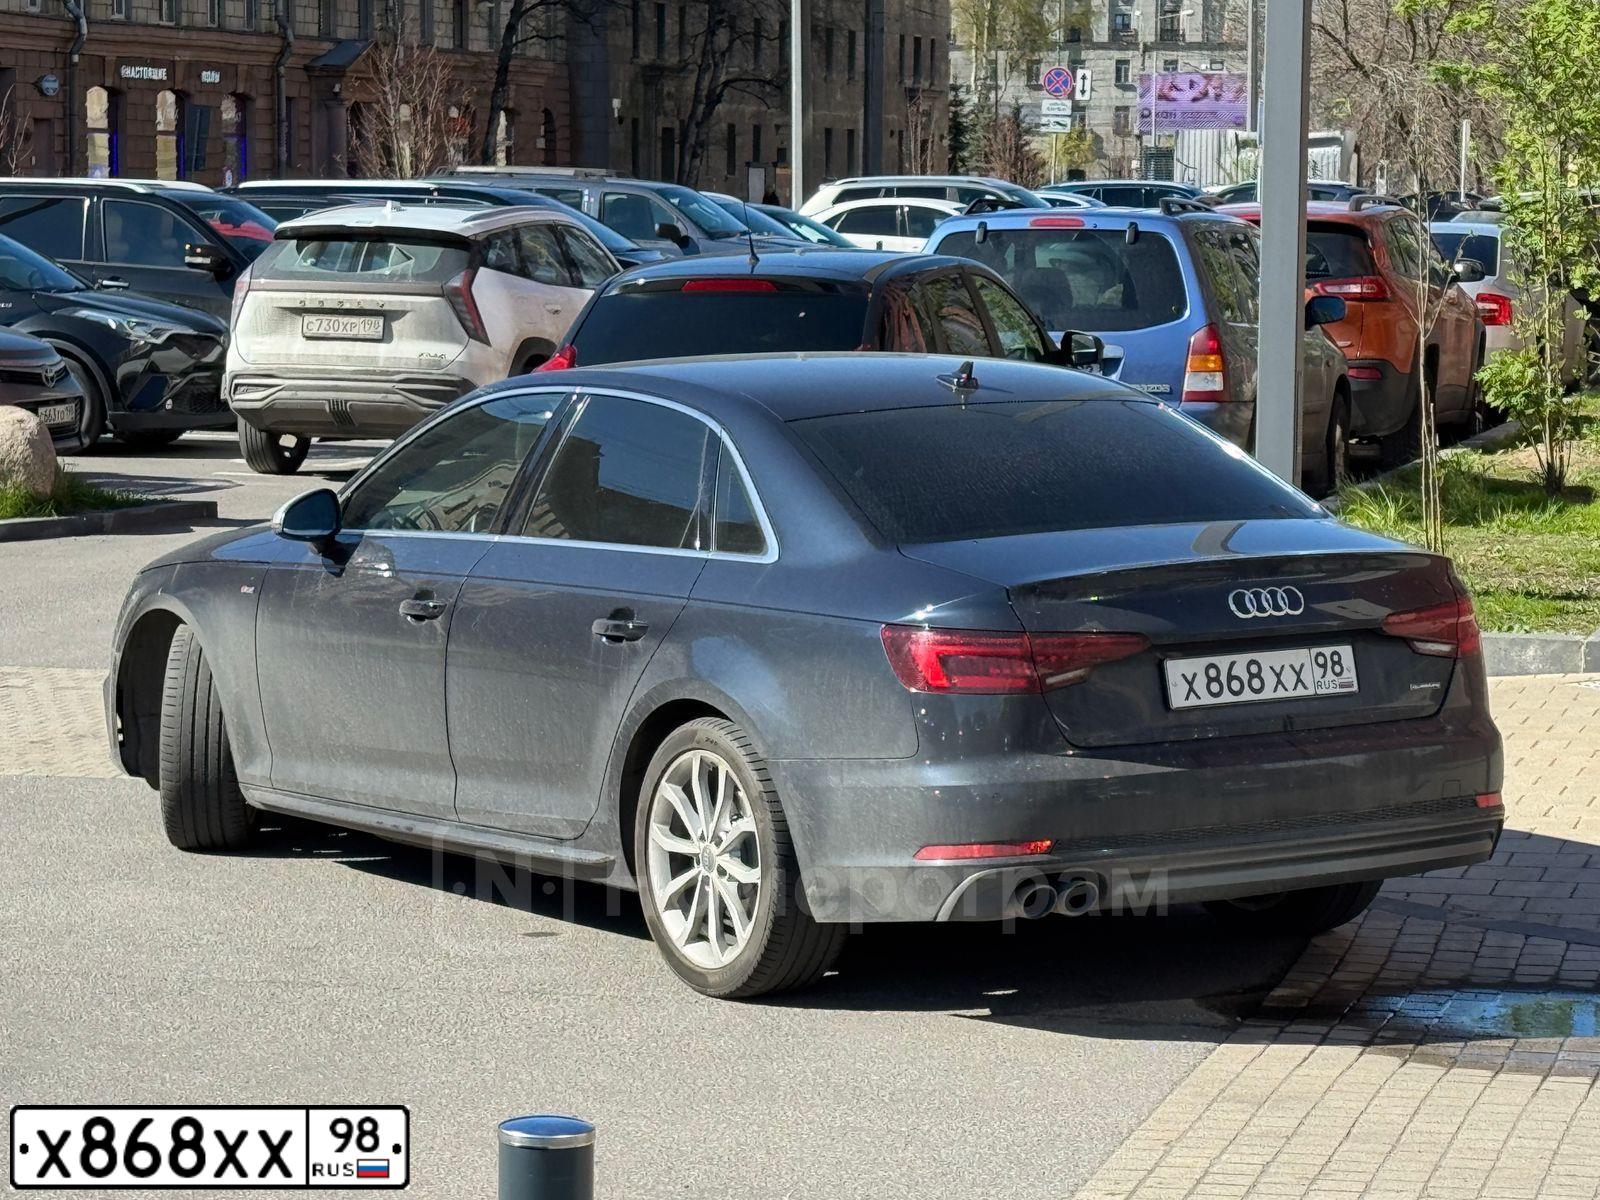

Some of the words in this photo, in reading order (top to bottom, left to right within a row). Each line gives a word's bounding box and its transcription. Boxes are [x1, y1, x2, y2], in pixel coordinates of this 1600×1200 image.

[1181, 658, 1309, 702] Х868ХХ
[1314, 650, 1345, 679] 98
[1316, 679, 1338, 690] RUS
